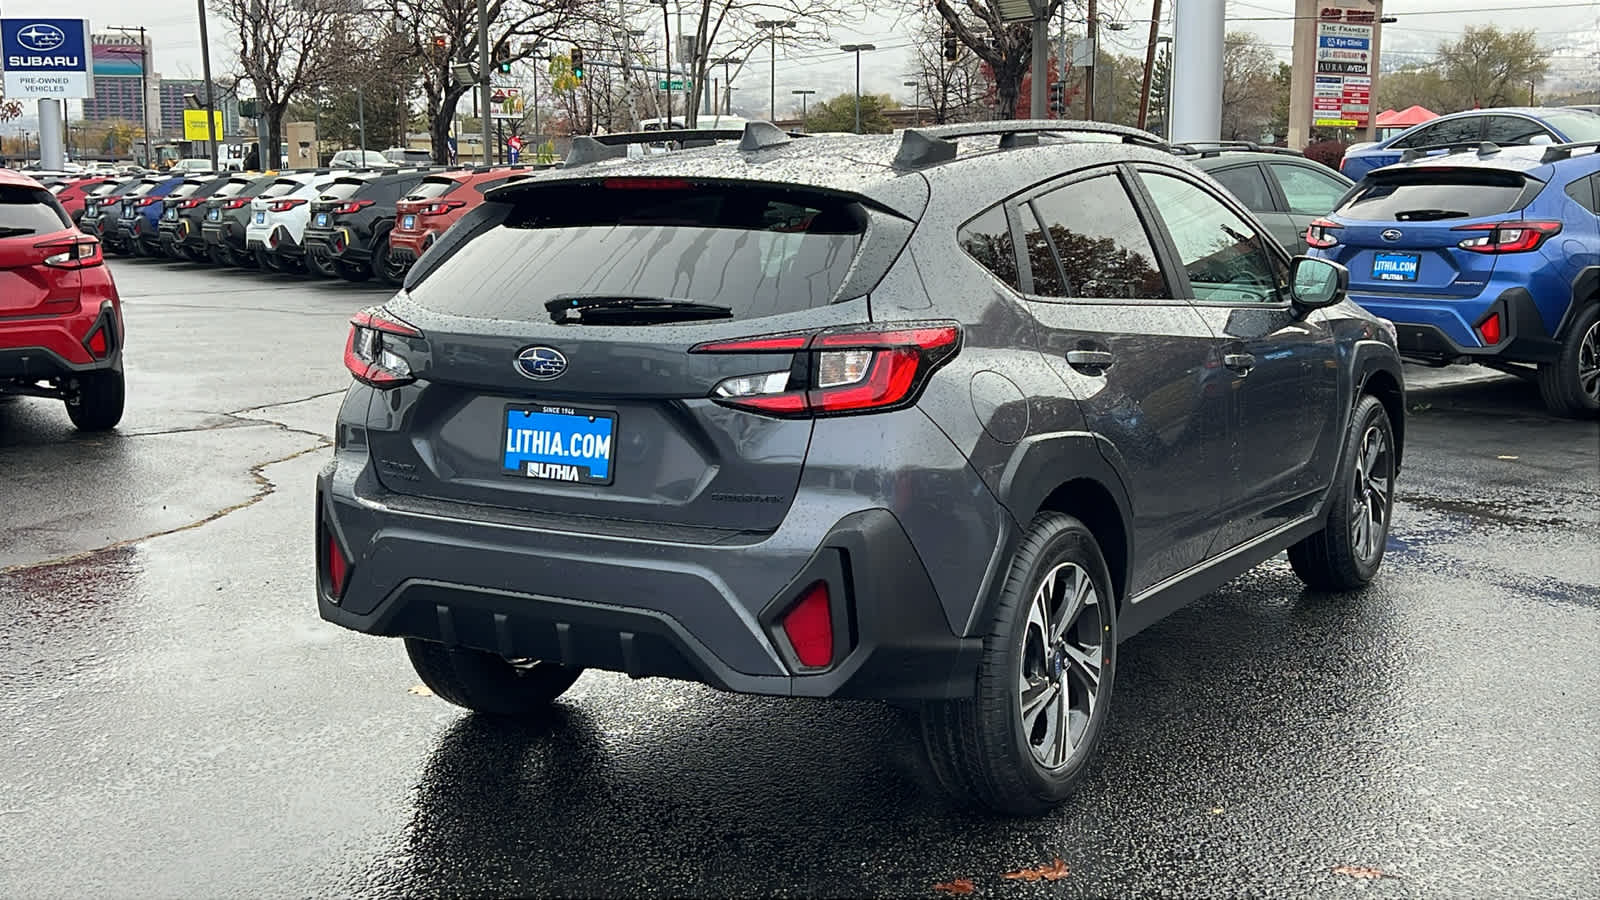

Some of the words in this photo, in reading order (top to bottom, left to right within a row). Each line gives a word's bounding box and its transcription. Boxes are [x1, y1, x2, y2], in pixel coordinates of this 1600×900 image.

[1321, 24, 1336, 32] THE
[1336, 39, 1346, 47] Eye
[1347, 39, 1363, 47] Clinic
[9, 56, 78, 66] SUBARU
[1319, 63, 1343, 71] AURA
[1346, 65, 1367, 73] AVEDA
[1374, 261, 1417, 272] LITHIA.COM
[543, 406, 560, 414] SINCE
[506, 428, 611, 460] LITHIA.COM
[539, 463, 579, 481] LITHIA
